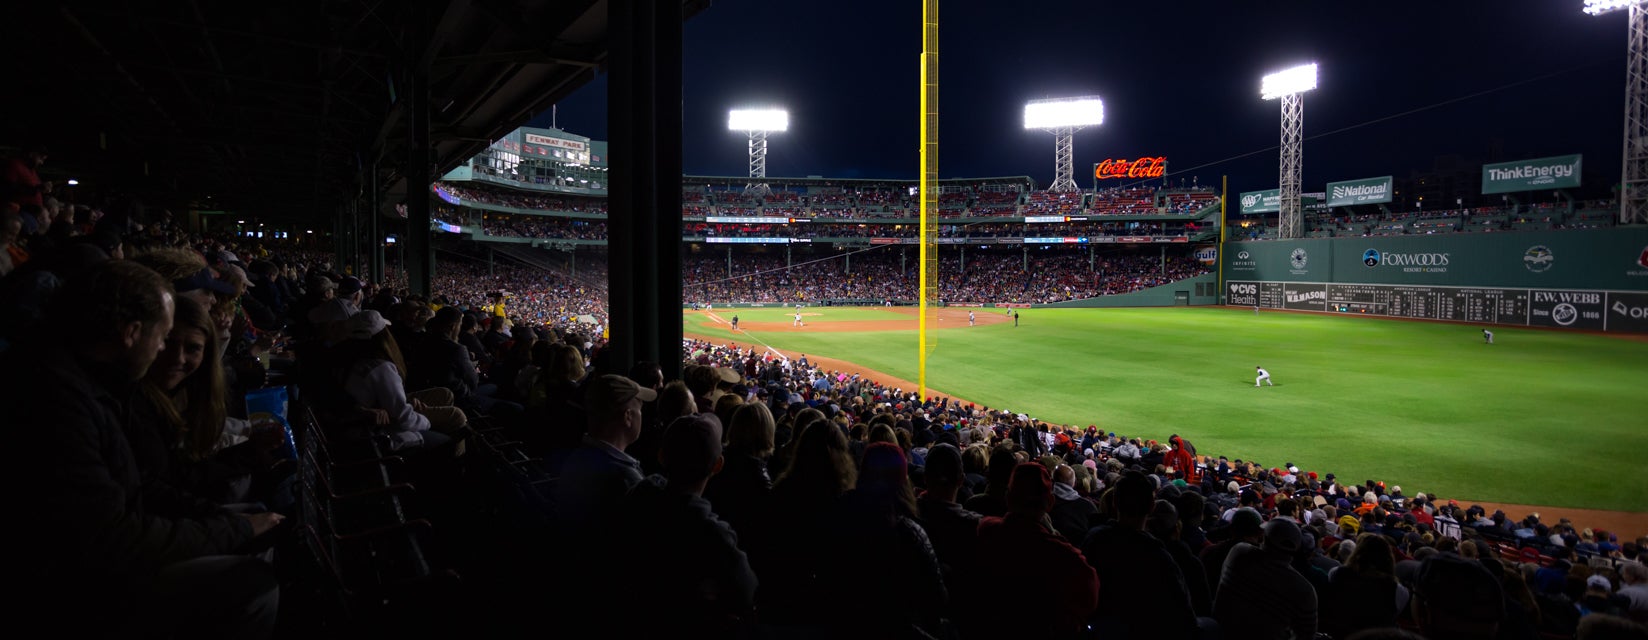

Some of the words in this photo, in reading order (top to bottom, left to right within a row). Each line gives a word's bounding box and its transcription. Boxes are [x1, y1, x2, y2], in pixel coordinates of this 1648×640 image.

[530, 136, 559, 145] FENWAY
[1095, 156, 1167, 179] Coca-Cola
[1344, 182, 1387, 197] National
[1195, 250, 1216, 260] Gulf
[1381, 252, 1449, 266] FOXWOODS
[1238, 284, 1257, 295] CVS
[1230, 294, 1256, 304] Health
[1559, 292, 1601, 304] WEBB
